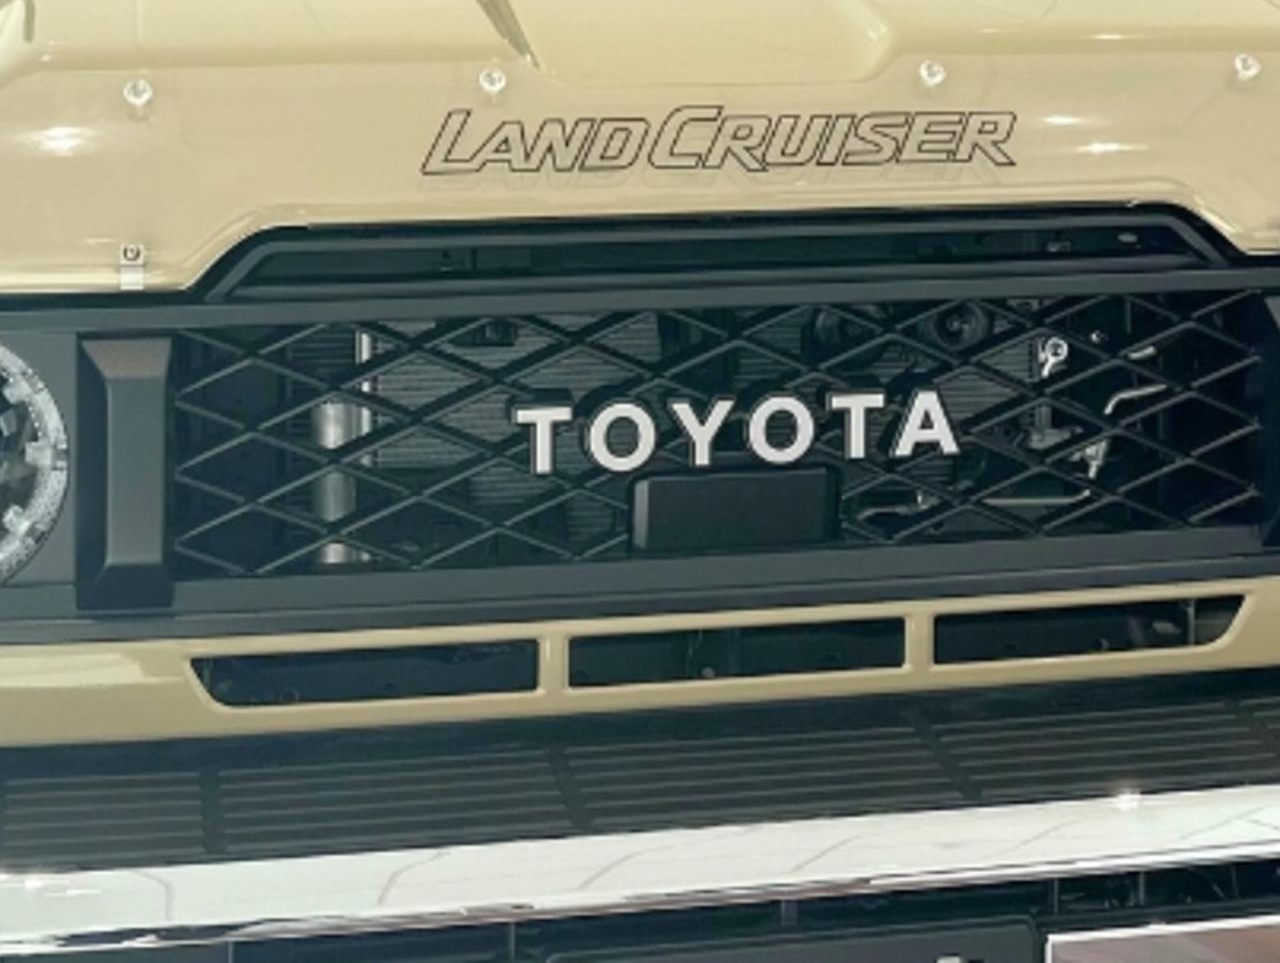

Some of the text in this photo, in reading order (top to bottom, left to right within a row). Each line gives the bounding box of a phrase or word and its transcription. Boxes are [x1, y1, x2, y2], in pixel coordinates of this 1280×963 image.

[420, 105, 1016, 175] LAND CRUISER
[515, 389, 960, 475] TOYOTA
